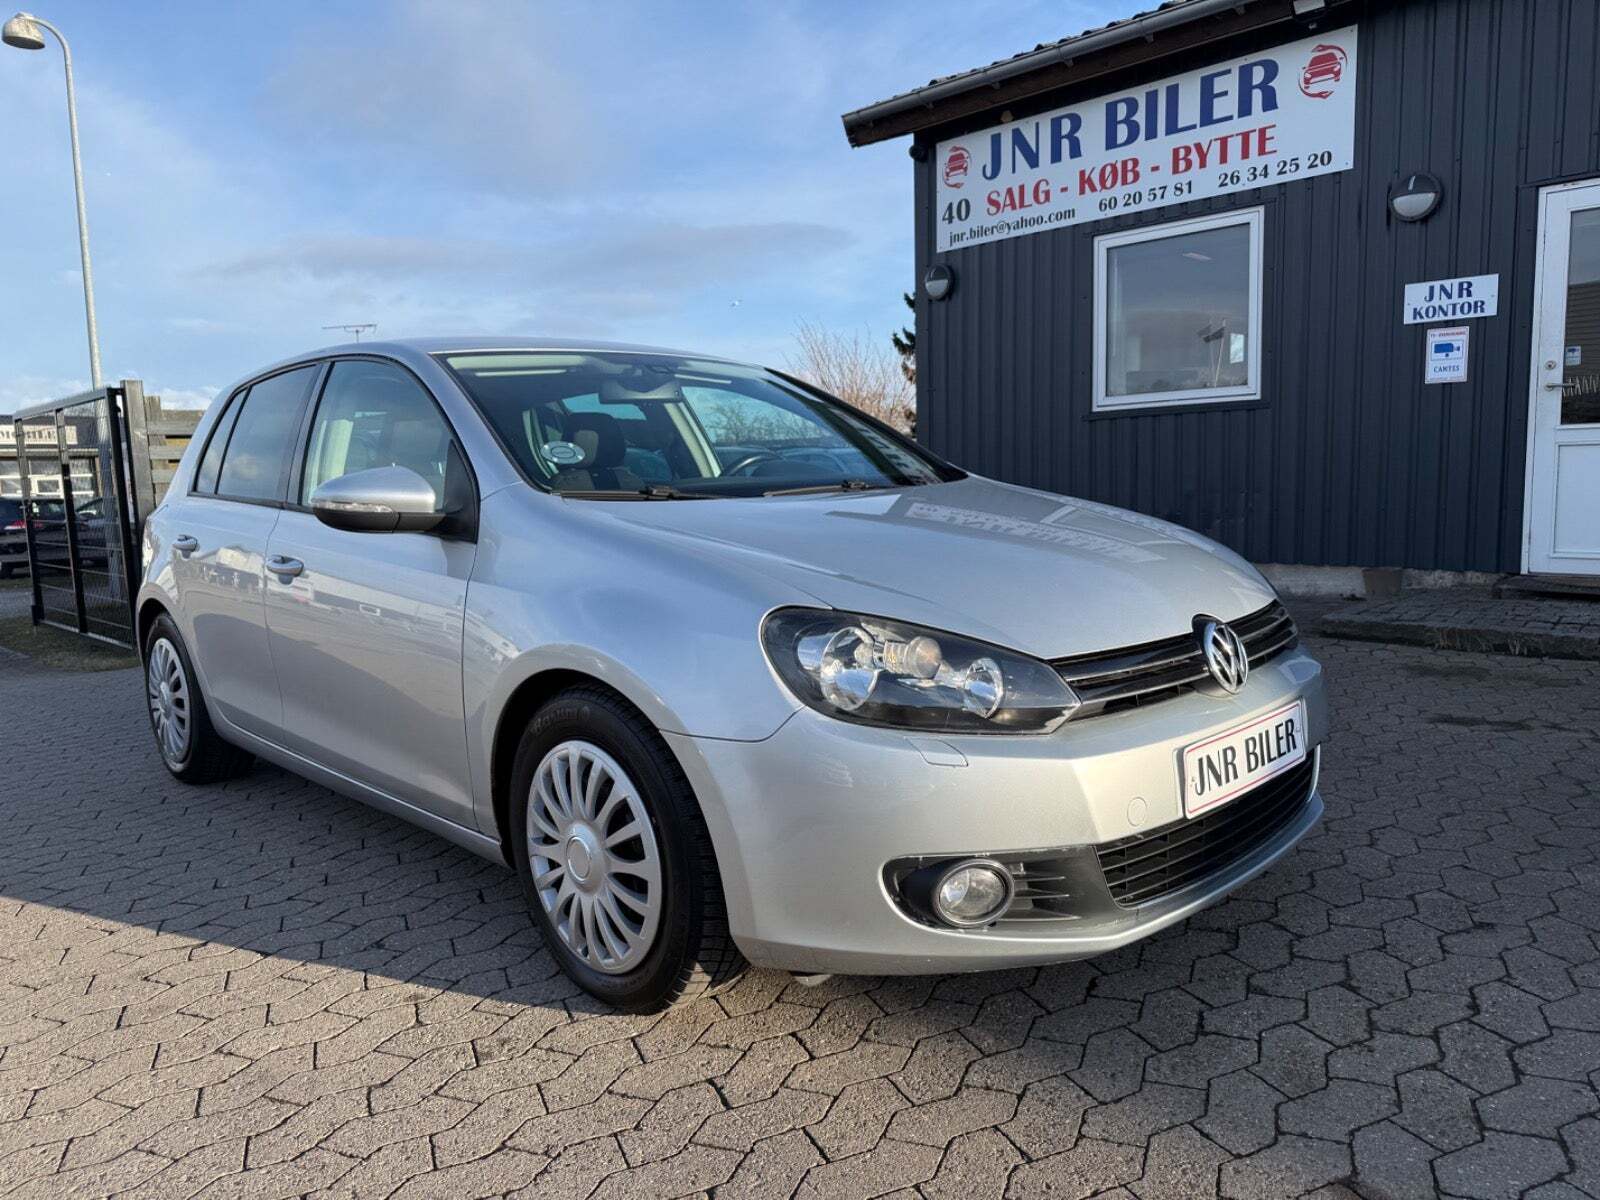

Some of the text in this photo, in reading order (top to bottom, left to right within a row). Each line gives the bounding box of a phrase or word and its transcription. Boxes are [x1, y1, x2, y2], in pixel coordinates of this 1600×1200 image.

[982, 58, 1279, 181] JNR BILER
[986, 178, 1051, 216] SALG
[1078, 157, 1141, 197] KØB
[1171, 124, 1278, 175] BYTTE
[1098, 150, 1333, 213] 60 20 57 81 26 34 25 20
[941, 198, 971, 225] 40
[949, 207, 1076, 247] jnr.biler@yahoo.com
[1412, 300, 1486, 320] KONTOR
[1424, 280, 1473, 302] JNR
[1195, 717, 1298, 796] JNR BILER
